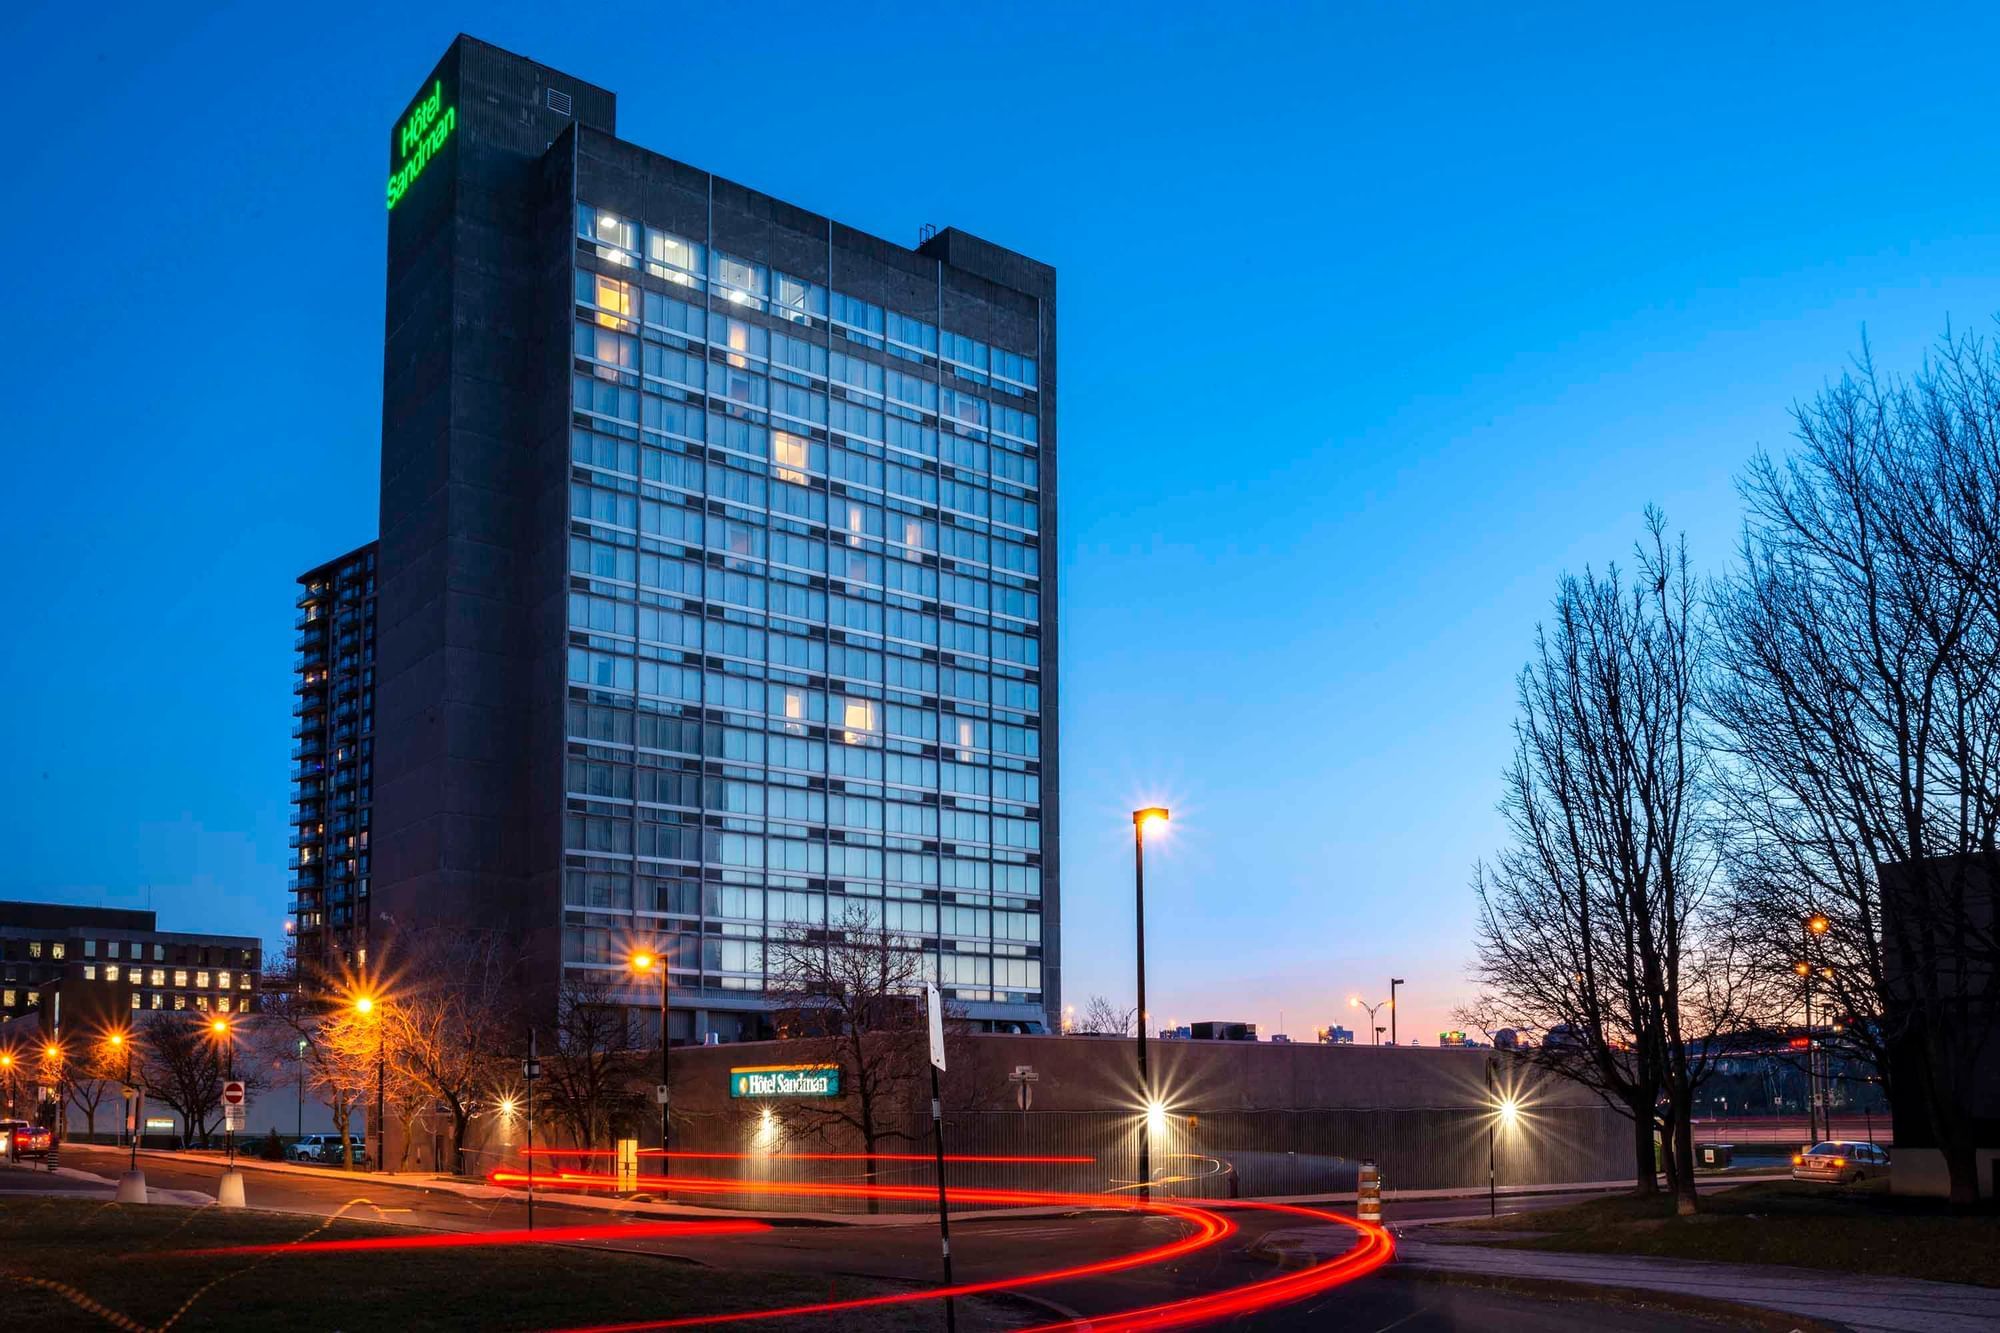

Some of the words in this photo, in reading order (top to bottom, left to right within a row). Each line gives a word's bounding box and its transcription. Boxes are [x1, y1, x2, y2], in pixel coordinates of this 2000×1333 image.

[401, 80, 440, 157] Hôtel
[386, 107, 455, 209] Sandman
[749, 1074, 776, 1094] Hôtel
[777, 1072, 828, 1093] Sandman
